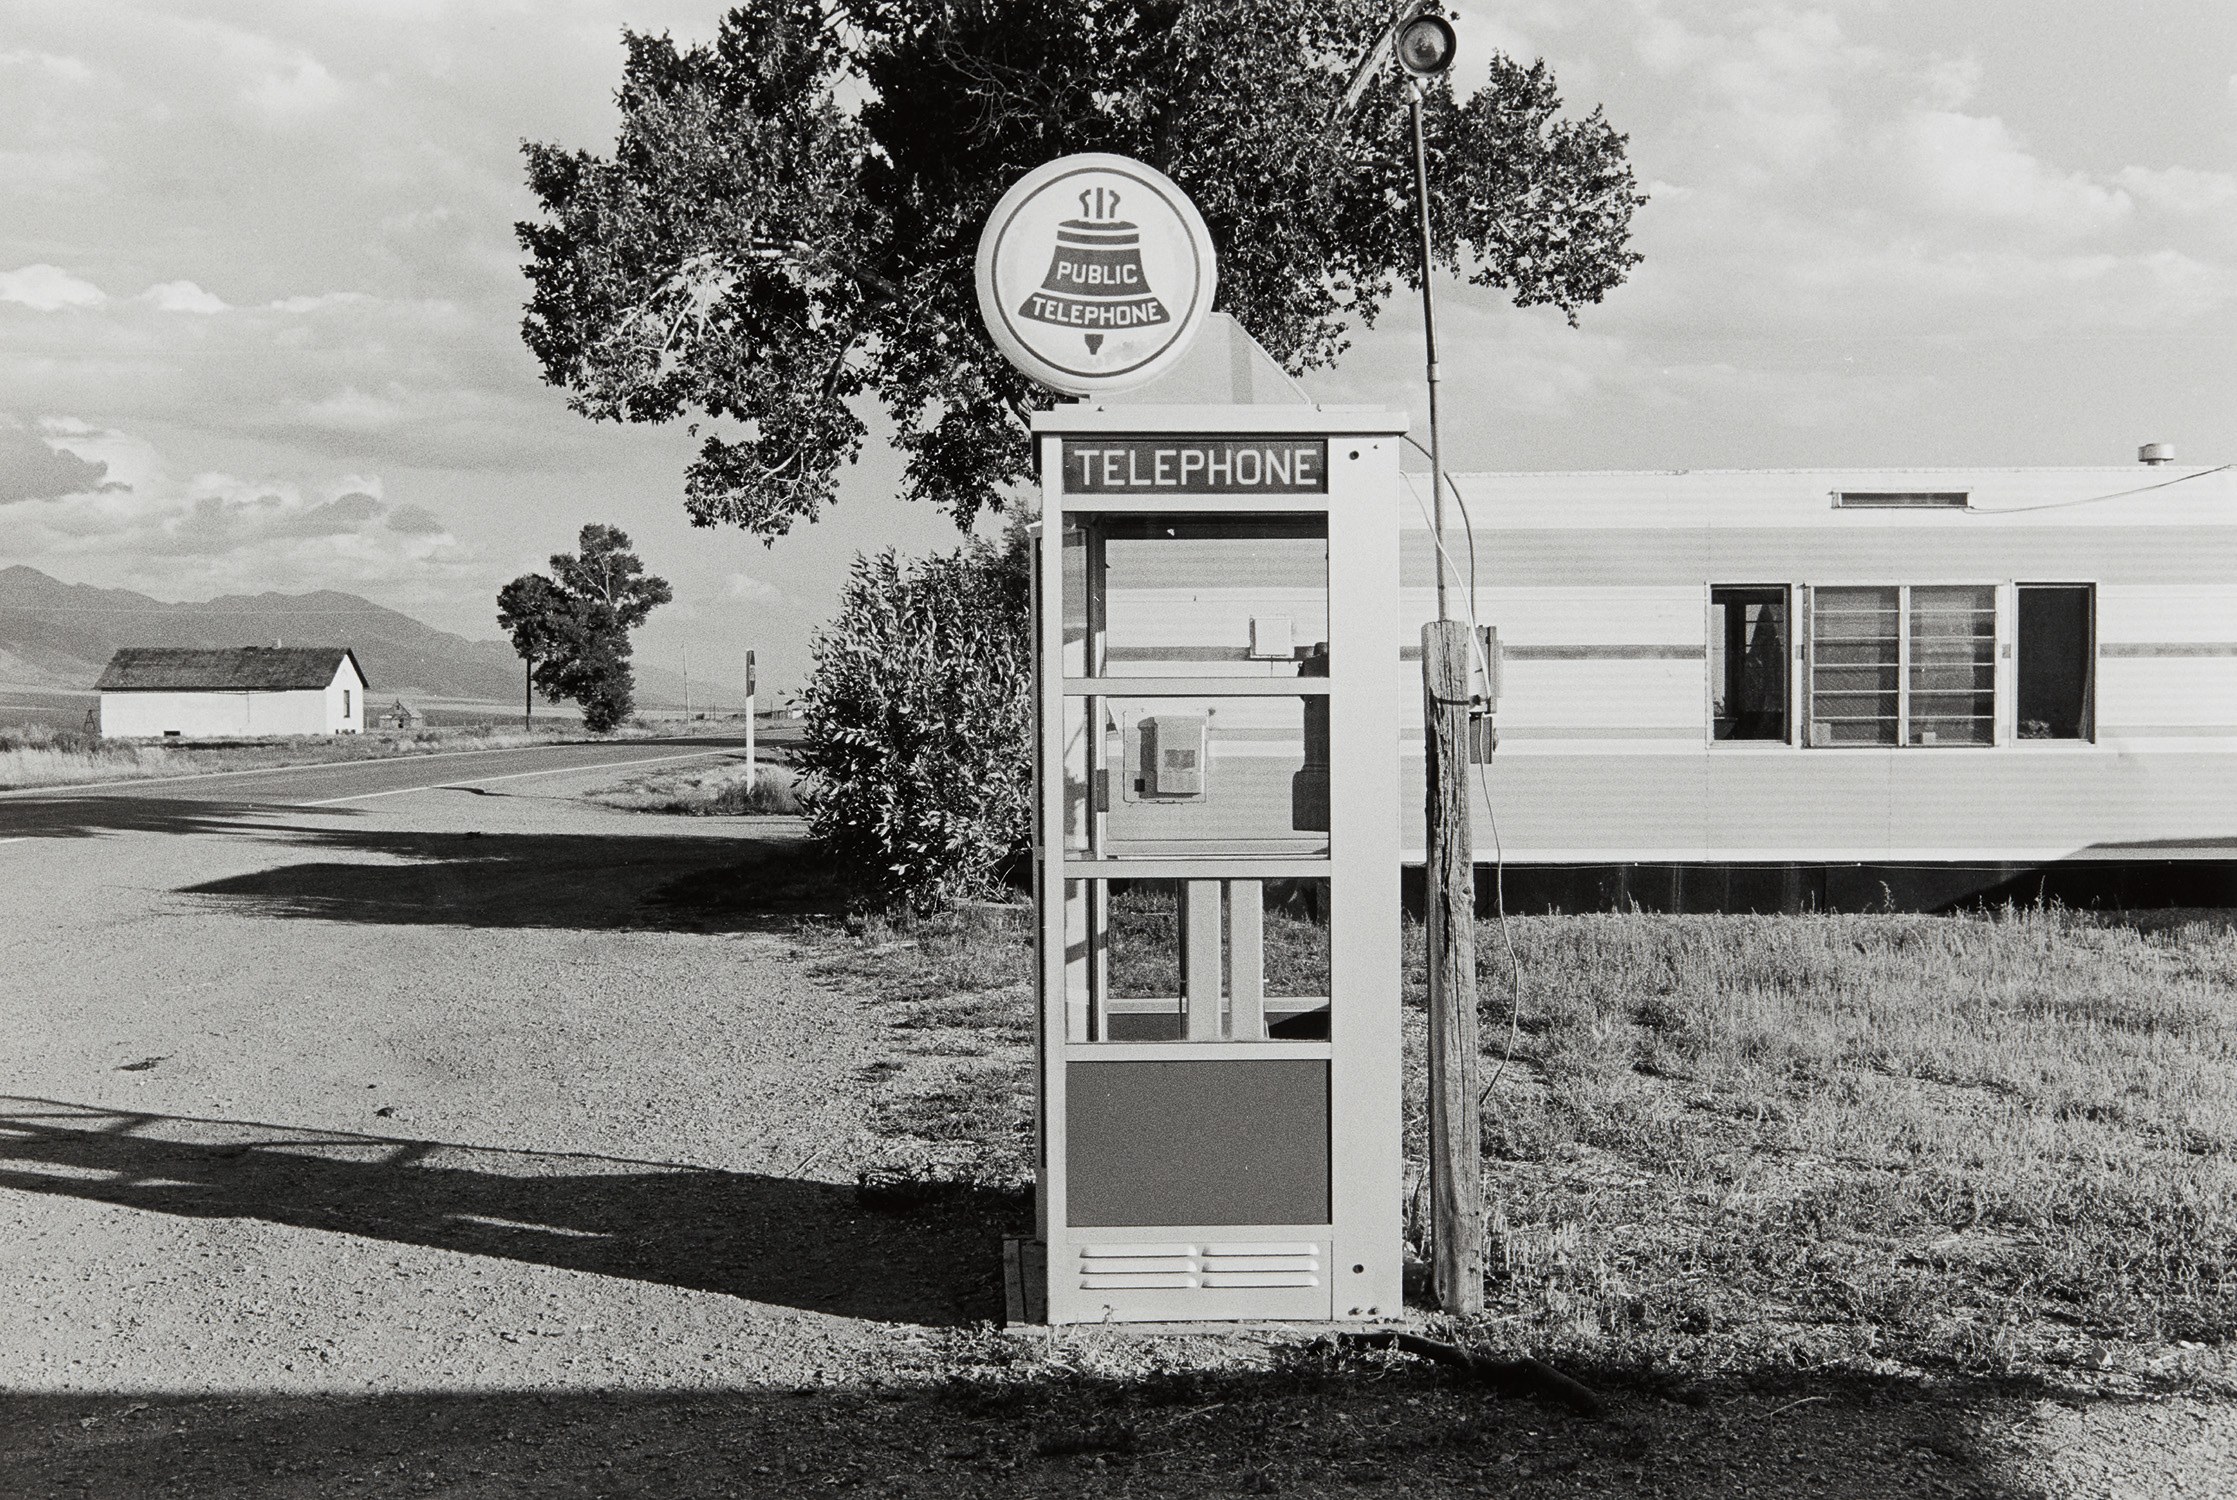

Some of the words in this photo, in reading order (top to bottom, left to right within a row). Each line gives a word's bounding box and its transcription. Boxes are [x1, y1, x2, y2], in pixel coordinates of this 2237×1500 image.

[1056, 261, 1138, 285] PUBLIC
[1032, 296, 1161, 326] TELEPHONE
[1073, 449, 1318, 486] TELEPHONE
